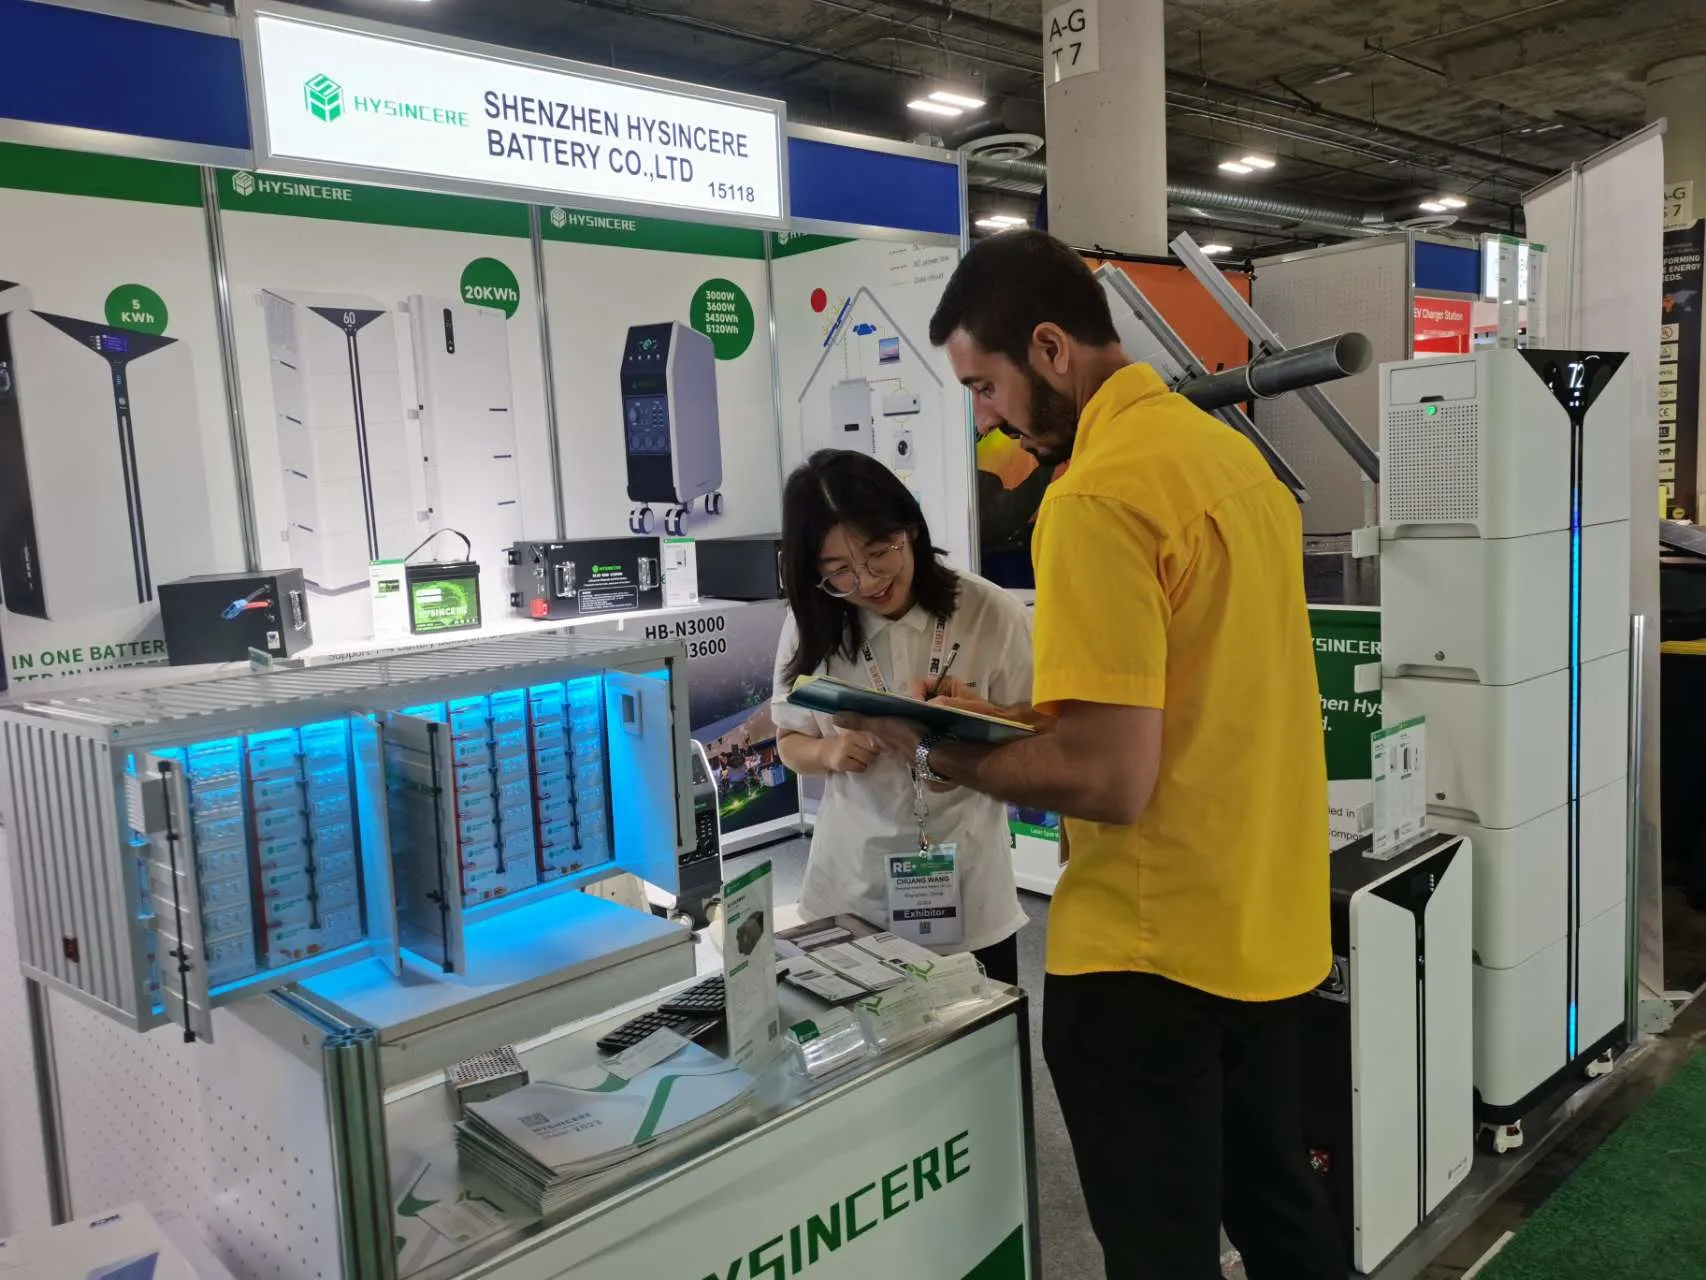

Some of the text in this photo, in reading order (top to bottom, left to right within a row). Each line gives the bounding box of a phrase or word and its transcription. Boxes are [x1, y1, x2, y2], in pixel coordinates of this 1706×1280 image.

[1049, 9, 1085, 42] A-G
[1069, 42, 1081, 66] 7
[354, 95, 470, 127] HYSINCERE
[484, 90, 749, 158] SHENZHEN HYSINCERE
[487, 128, 694, 182] BATTERY CO.,LTD
[258, 179, 353, 201] HYSINCERE
[708, 182, 755, 202] 15118
[1671, 204, 1682, 217] 7
[568, 213, 637, 232] HYSINCERE
[1669, 262, 1701, 274] ENERGY
[464, 285, 517, 301] 20KWh
[705, 290, 735, 301] 3000W
[131, 299, 141, 310] 5
[706, 302, 735, 312] 3600W
[121, 311, 155, 324] KWh
[343, 311, 356, 325] 60
[1423, 308, 1444, 322] Charger
[1445, 310, 1463, 321] Station
[706, 323, 739, 334] 5120Wh
[1567, 362, 1585, 388] 72
[645, 615, 725, 640] HB-N3000
[1312, 637, 1382, 655] SINCER
[12, 655, 33, 670] IN
[40, 647, 84, 667] ONE
[904, 908, 945, 919] Exhibitor
